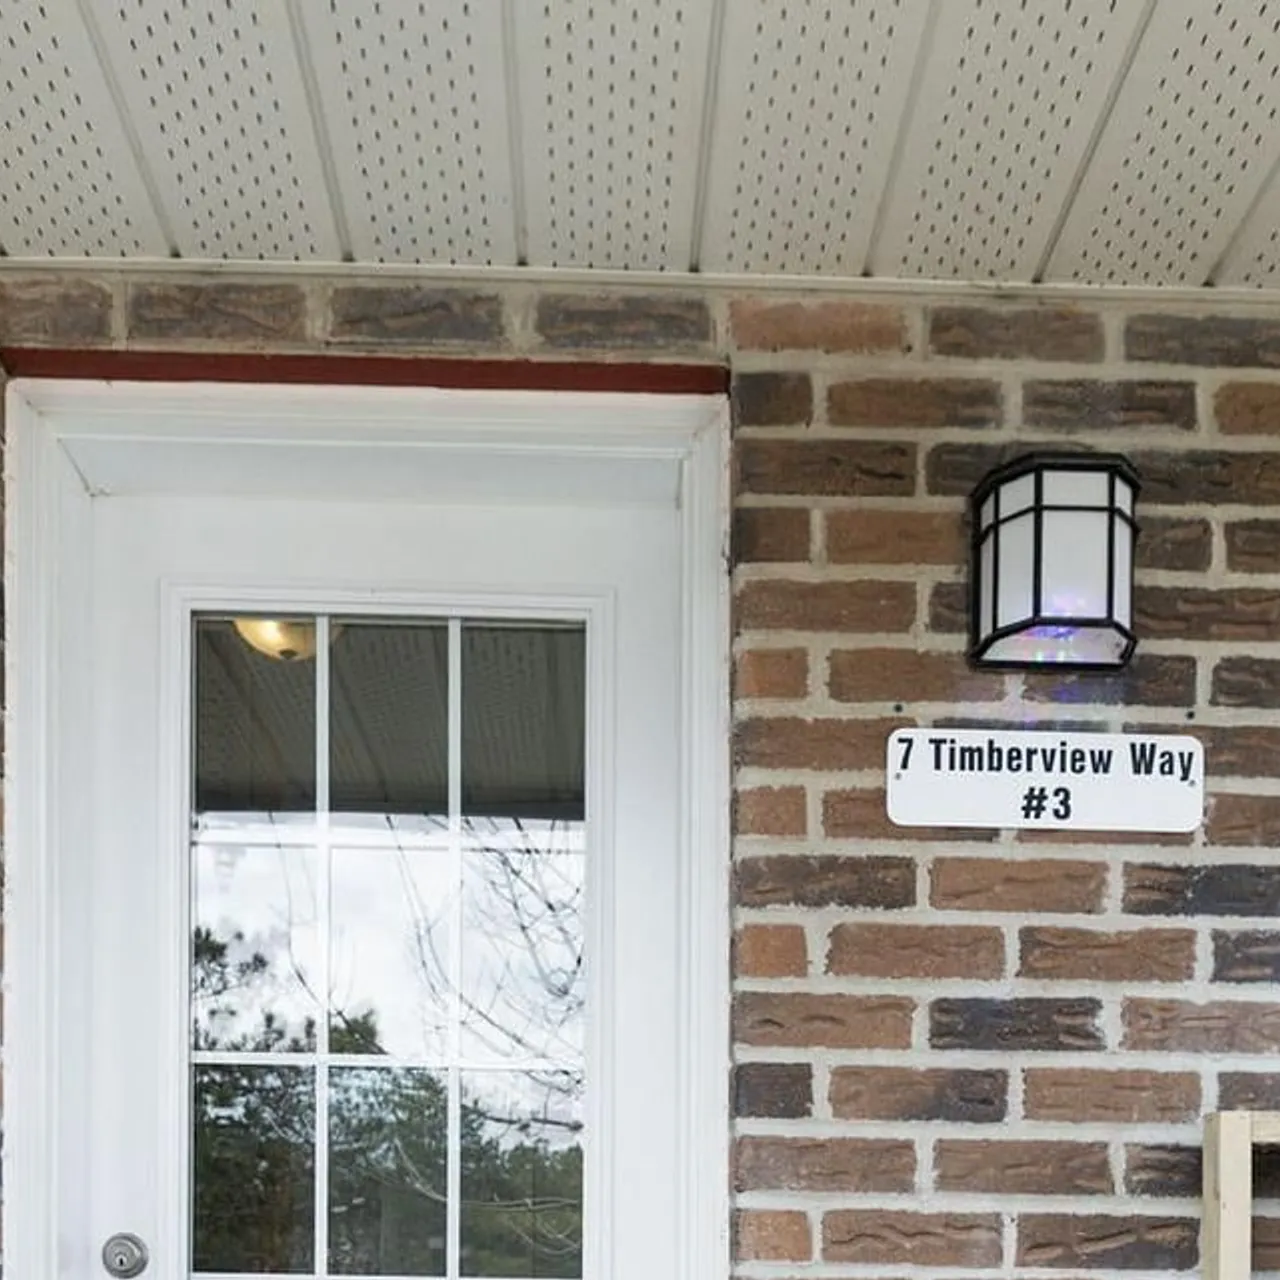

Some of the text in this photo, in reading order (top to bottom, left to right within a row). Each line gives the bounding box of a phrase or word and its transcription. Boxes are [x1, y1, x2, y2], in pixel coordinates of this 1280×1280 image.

[896, 737, 1195, 782] 7 Timberview Way
[1021, 786, 1072, 820] #3
